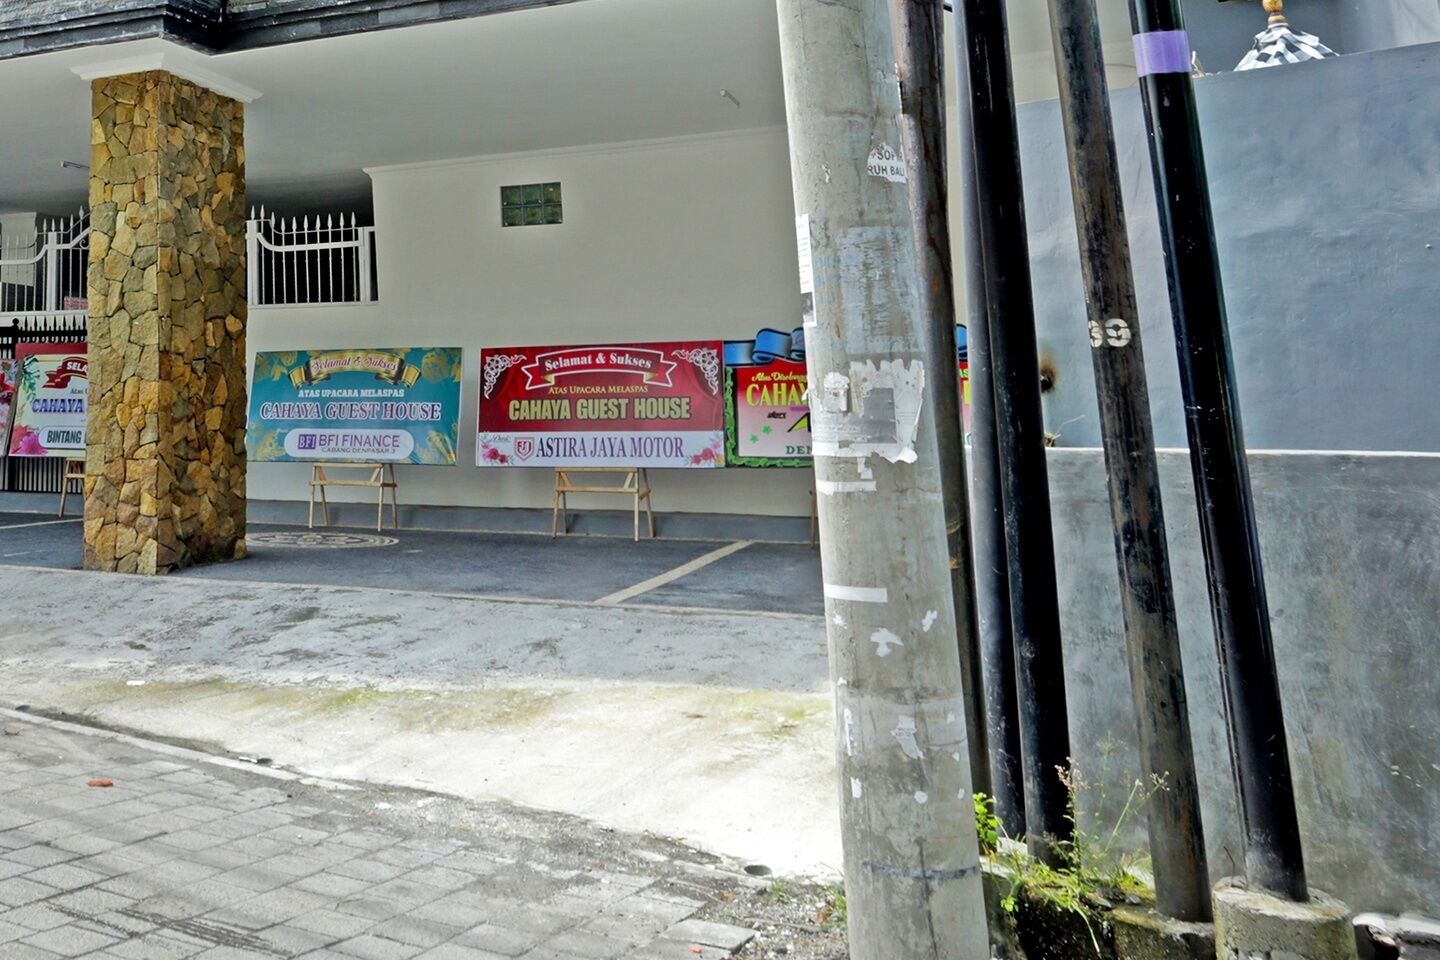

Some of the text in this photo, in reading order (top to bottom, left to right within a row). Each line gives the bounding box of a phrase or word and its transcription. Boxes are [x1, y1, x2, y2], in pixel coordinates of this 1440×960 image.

[311, 355, 397, 371] Selamat & Sukses
[544, 352, 652, 372] Selamat & Sukses
[298, 389, 405, 398] ATAS UPACARA MELASPAS
[31, 398, 85, 414] CAHAYA
[259, 401, 442, 421] CAHAYA GUEST HOUSE
[509, 396, 691, 421] CAHAYA GUEST HOUSE
[46, 430, 82, 444] BINTANG
[298, 434, 316, 449] BFI
[318, 434, 400, 448] BFI FINANCE
[536, 437, 586, 458] ASTIRA
[590, 437, 627, 458] JAYA
[627, 436, 685, 458] MOTOR
